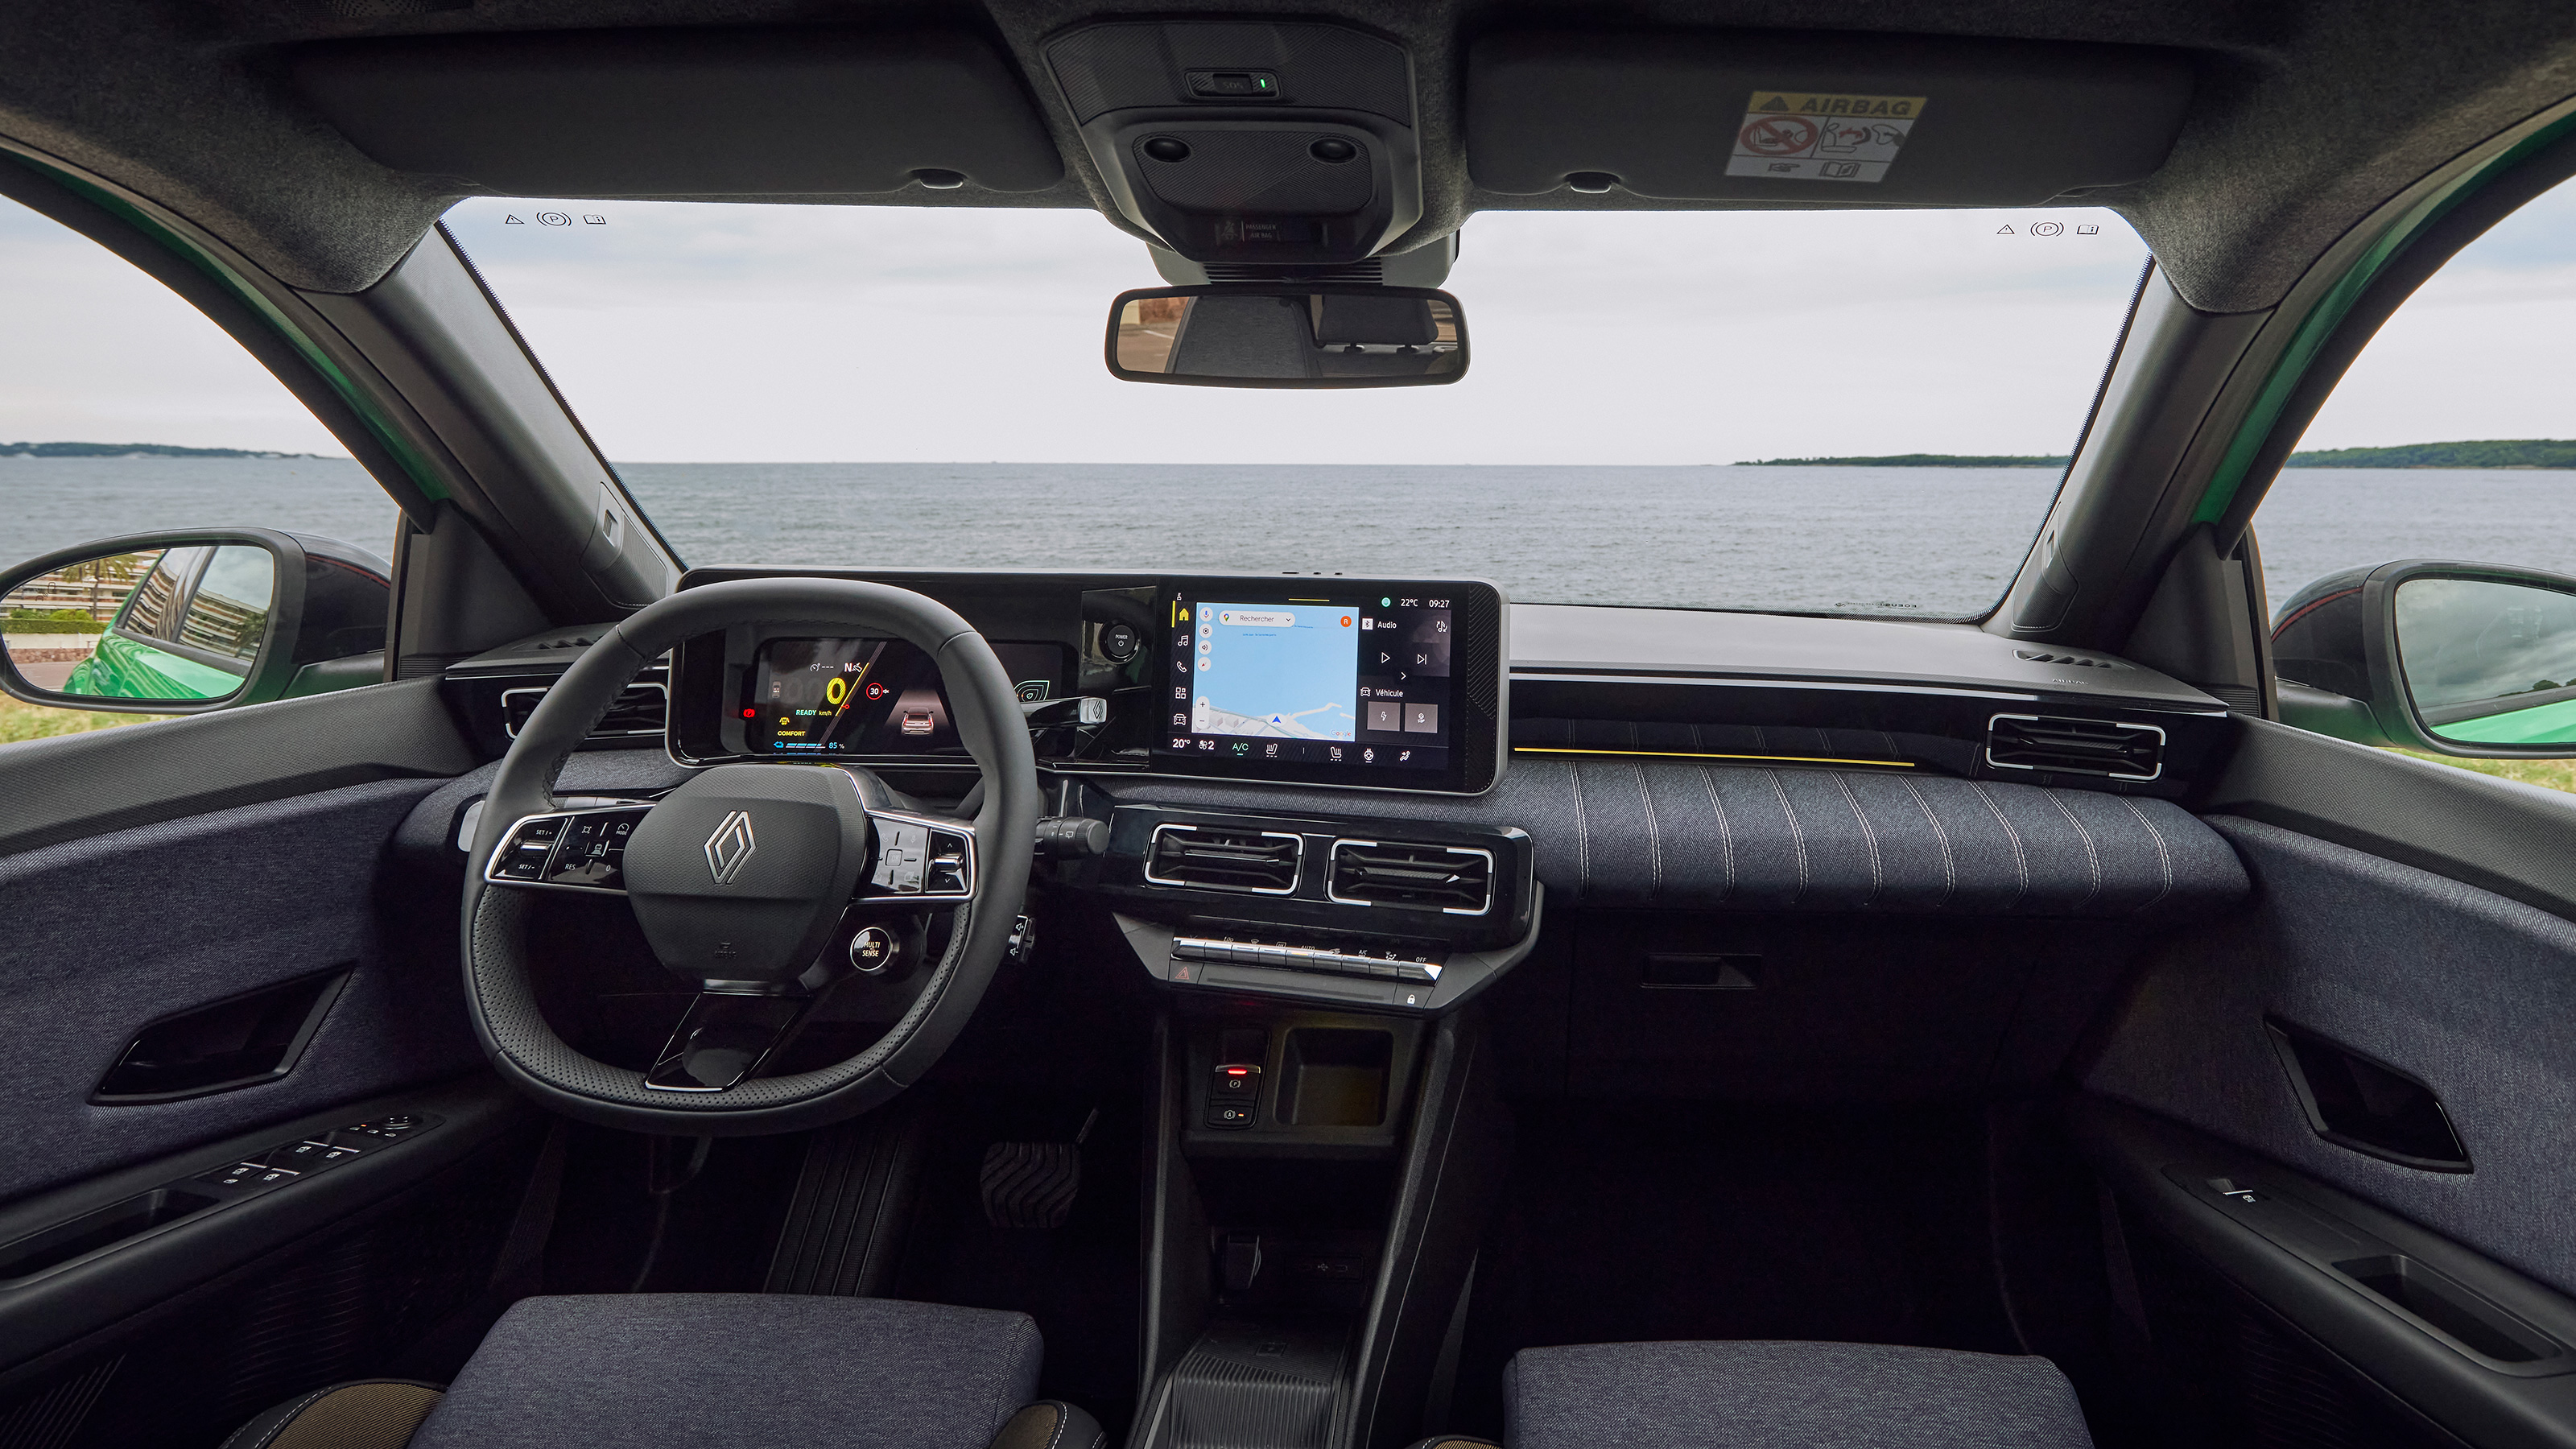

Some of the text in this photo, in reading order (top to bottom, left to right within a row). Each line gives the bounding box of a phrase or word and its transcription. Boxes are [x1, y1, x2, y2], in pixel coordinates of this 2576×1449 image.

[1799, 97, 1913, 115] AIRBAG
[1400, 598, 1450, 608] 22°C 09:27
[1240, 614, 1275, 623] Rechercher
[1377, 621, 1397, 629] Audio
[844, 663, 852, 672] N
[869, 687, 879, 696] 30
[1375, 688, 1404, 698] Véhicule
[1330, 729, 1352, 738] Google
[1232, 742, 1249, 752] A/C
[564, 863, 576, 871] RES
[861, 950, 880, 958] SENSE
